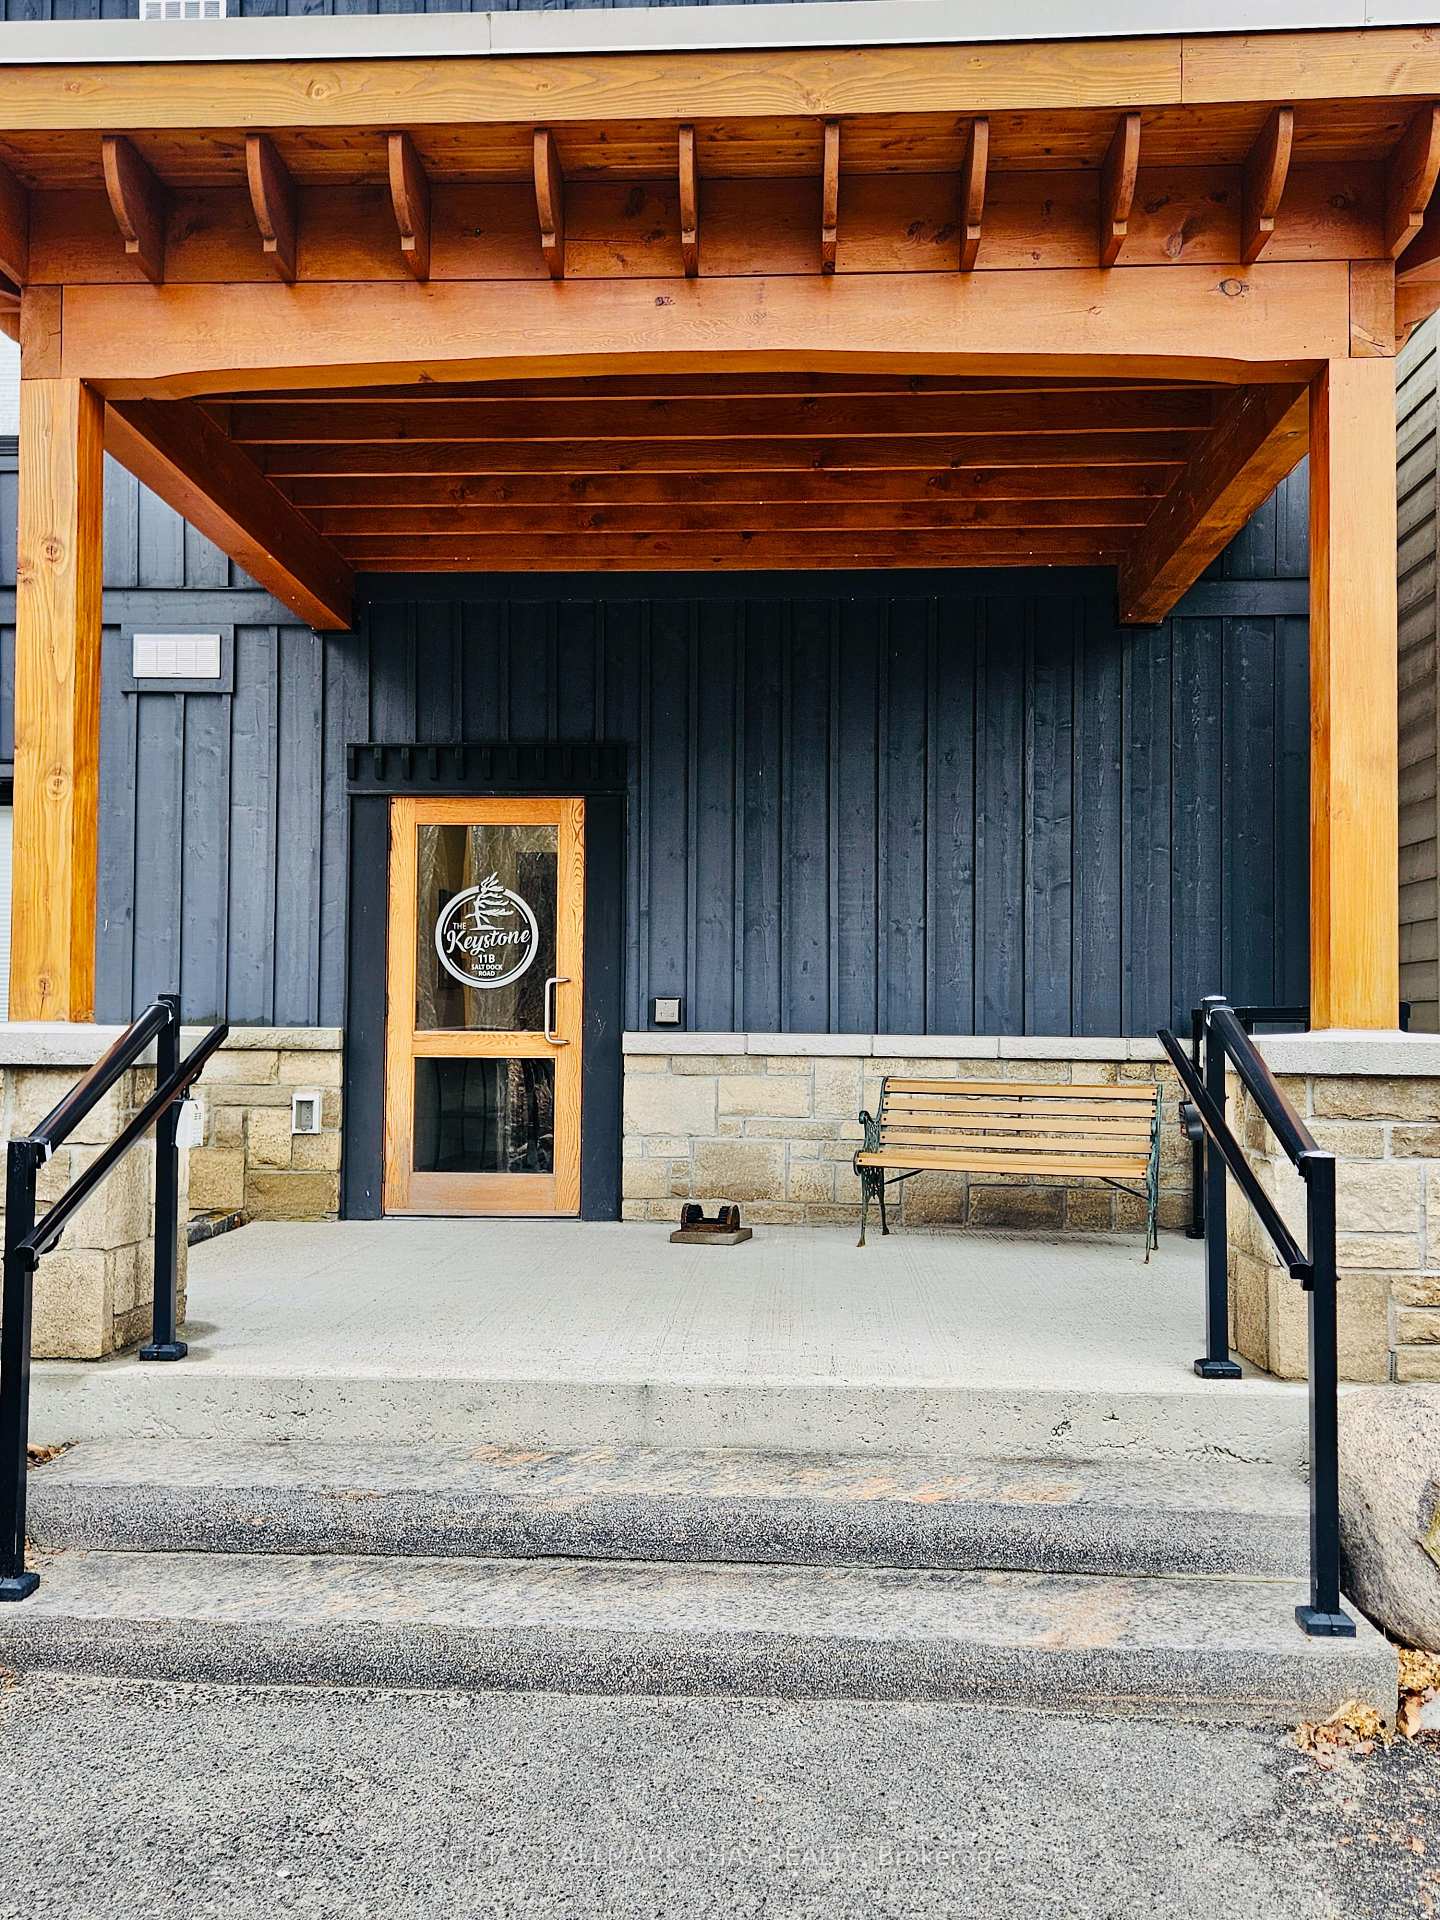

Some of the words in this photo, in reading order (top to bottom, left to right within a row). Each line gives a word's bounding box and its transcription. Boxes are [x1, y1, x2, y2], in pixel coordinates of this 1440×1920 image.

[453, 922, 467, 930] THE
[446, 929, 531, 955] Keystone
[478, 954, 496, 964] 11B
